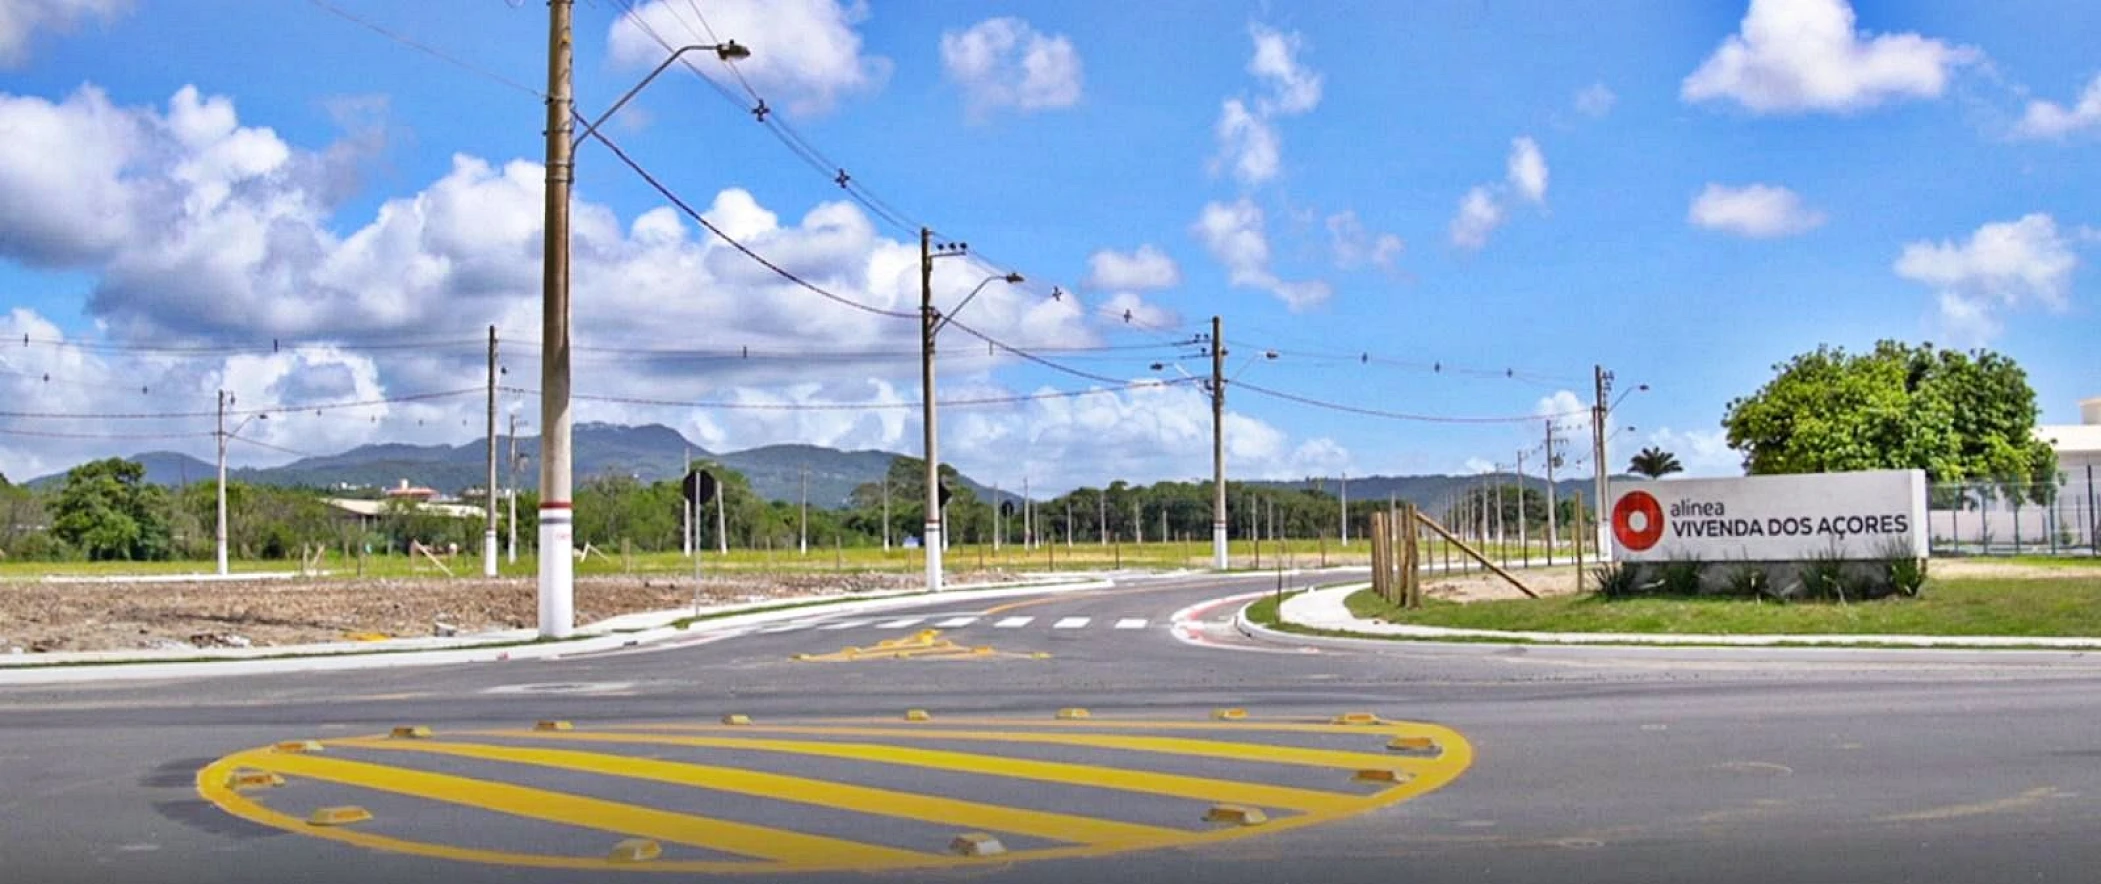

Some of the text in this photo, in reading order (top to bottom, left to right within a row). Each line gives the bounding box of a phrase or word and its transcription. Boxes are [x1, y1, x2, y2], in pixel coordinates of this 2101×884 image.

[1672, 514, 1909, 540] VIVENDA DOS AÇORES
